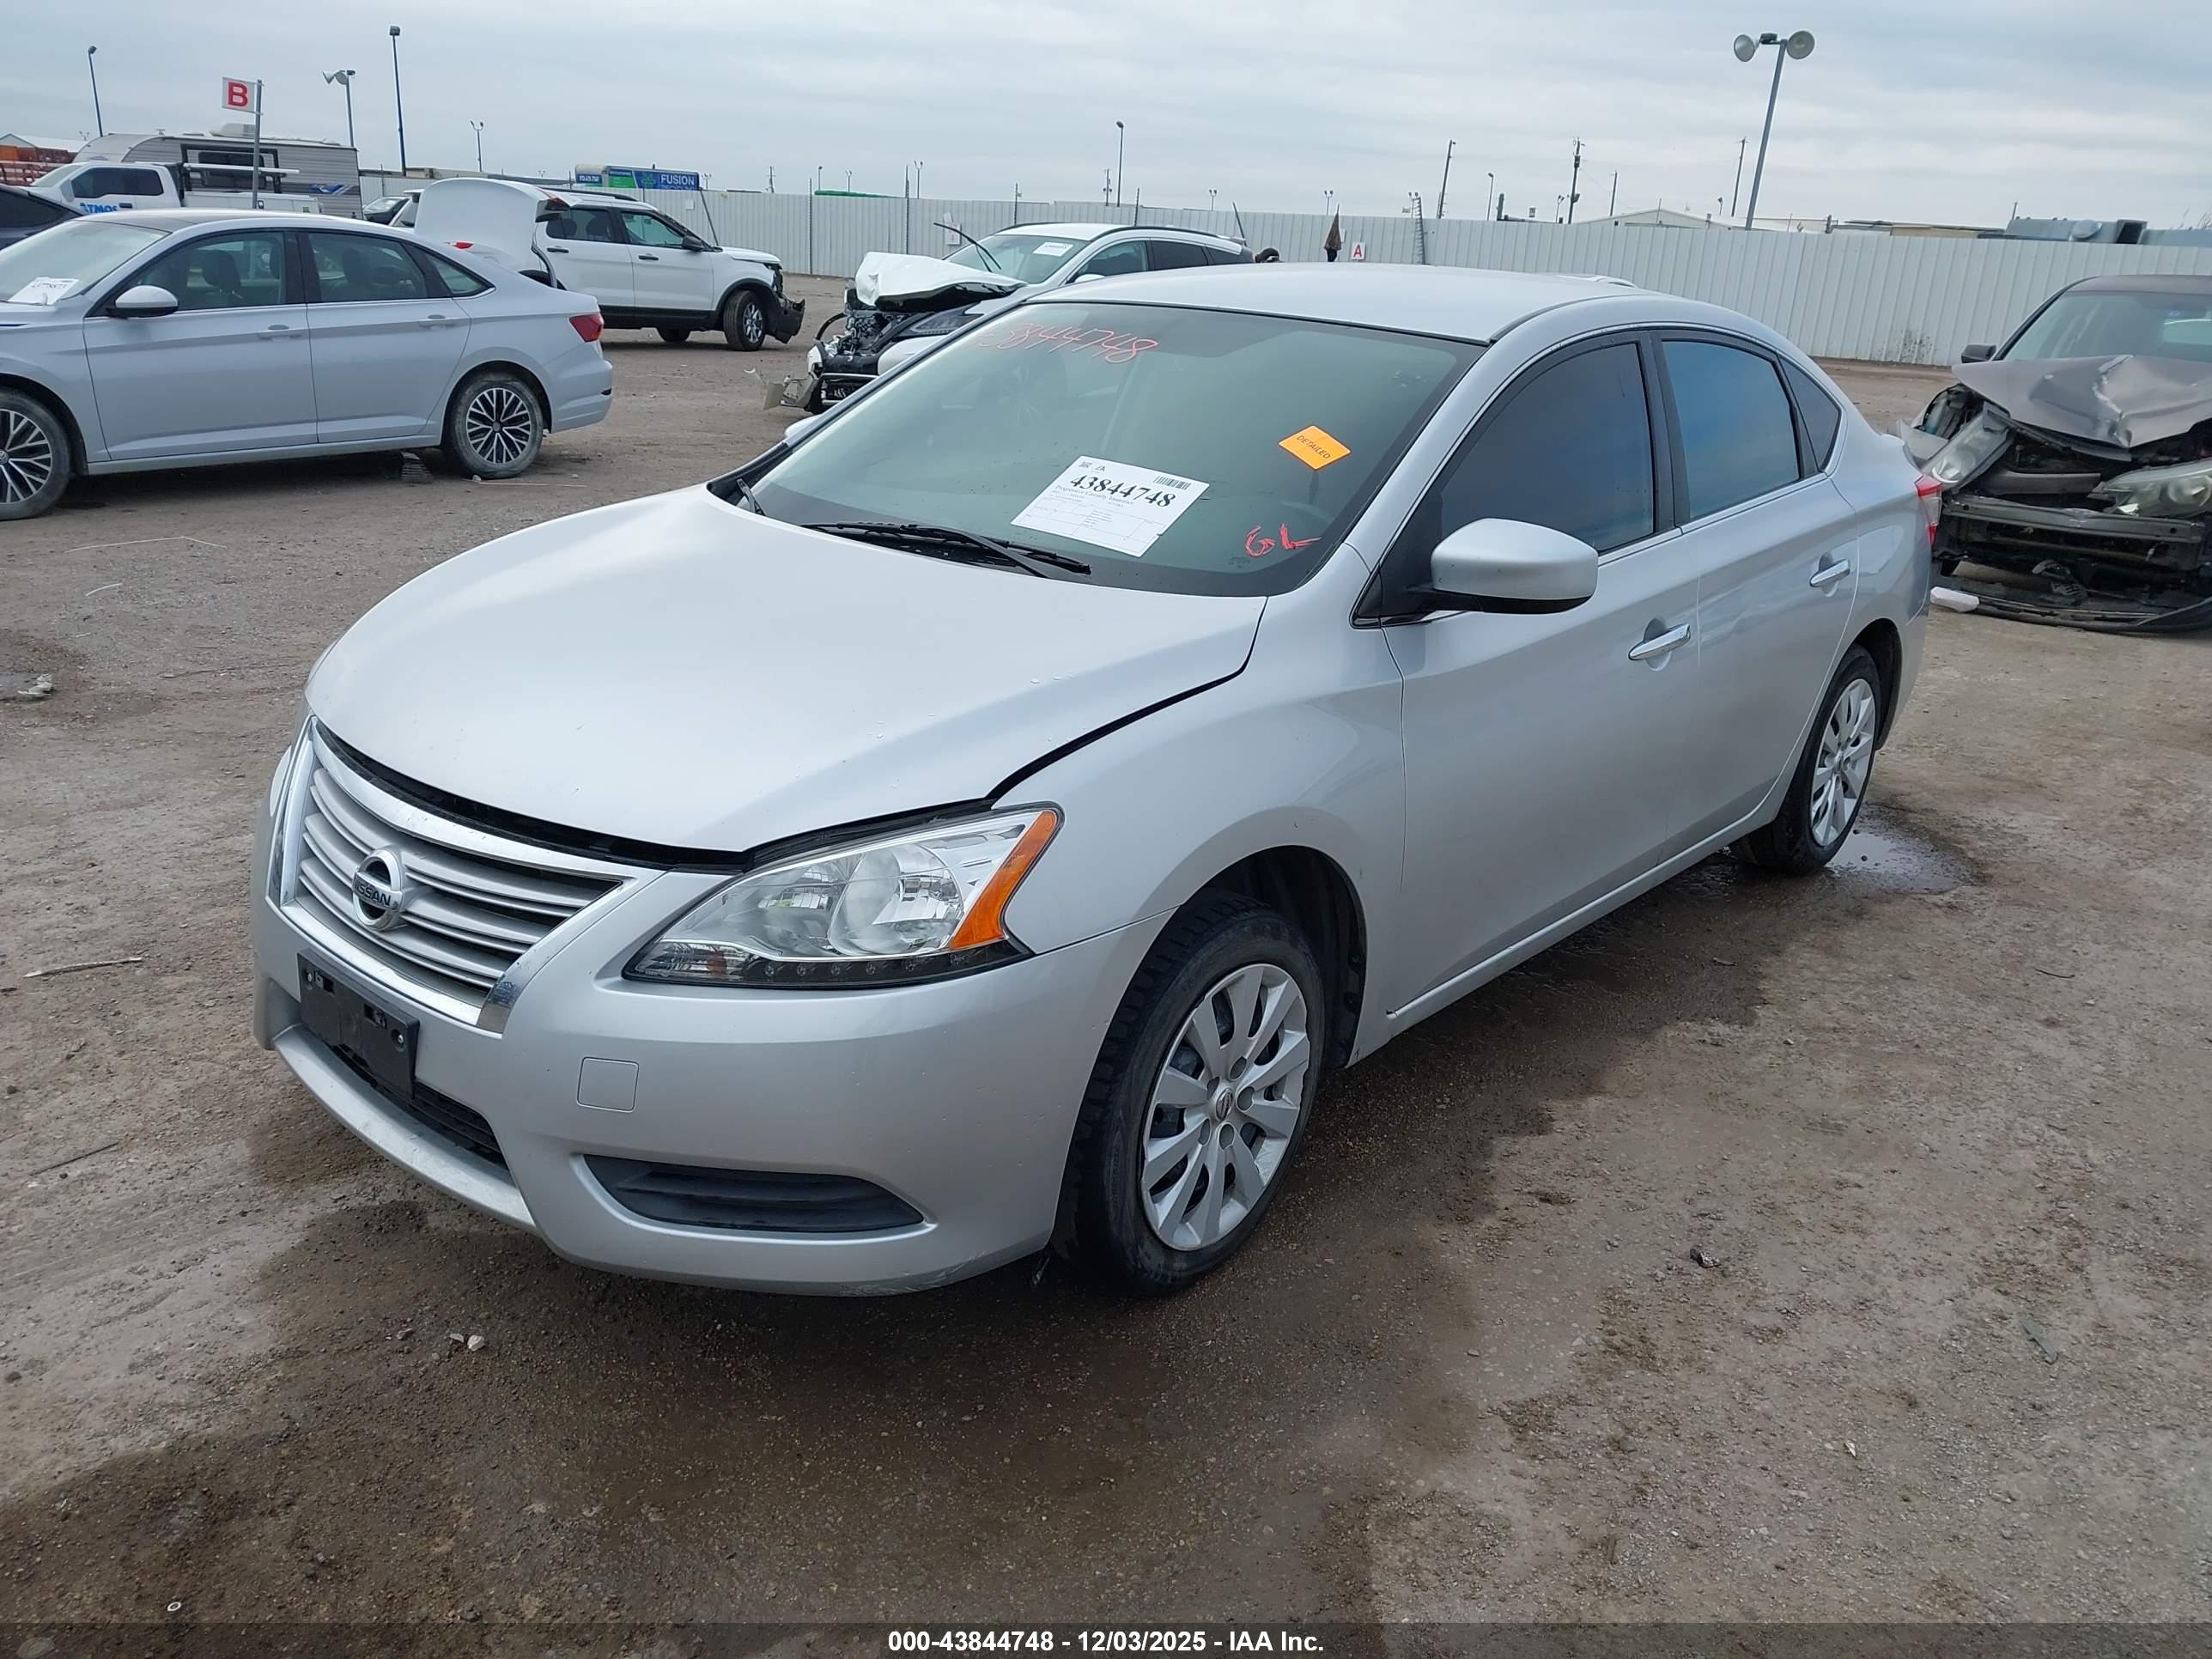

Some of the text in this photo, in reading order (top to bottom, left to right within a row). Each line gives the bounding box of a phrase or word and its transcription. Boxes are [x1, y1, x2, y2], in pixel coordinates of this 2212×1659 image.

[228, 82, 248, 107] B
[661, 173, 695, 185] FUSION
[1352, 244, 1363, 258] A
[1297, 434, 1331, 459] DETAILED
[1070, 475, 1176, 507] 43844748
